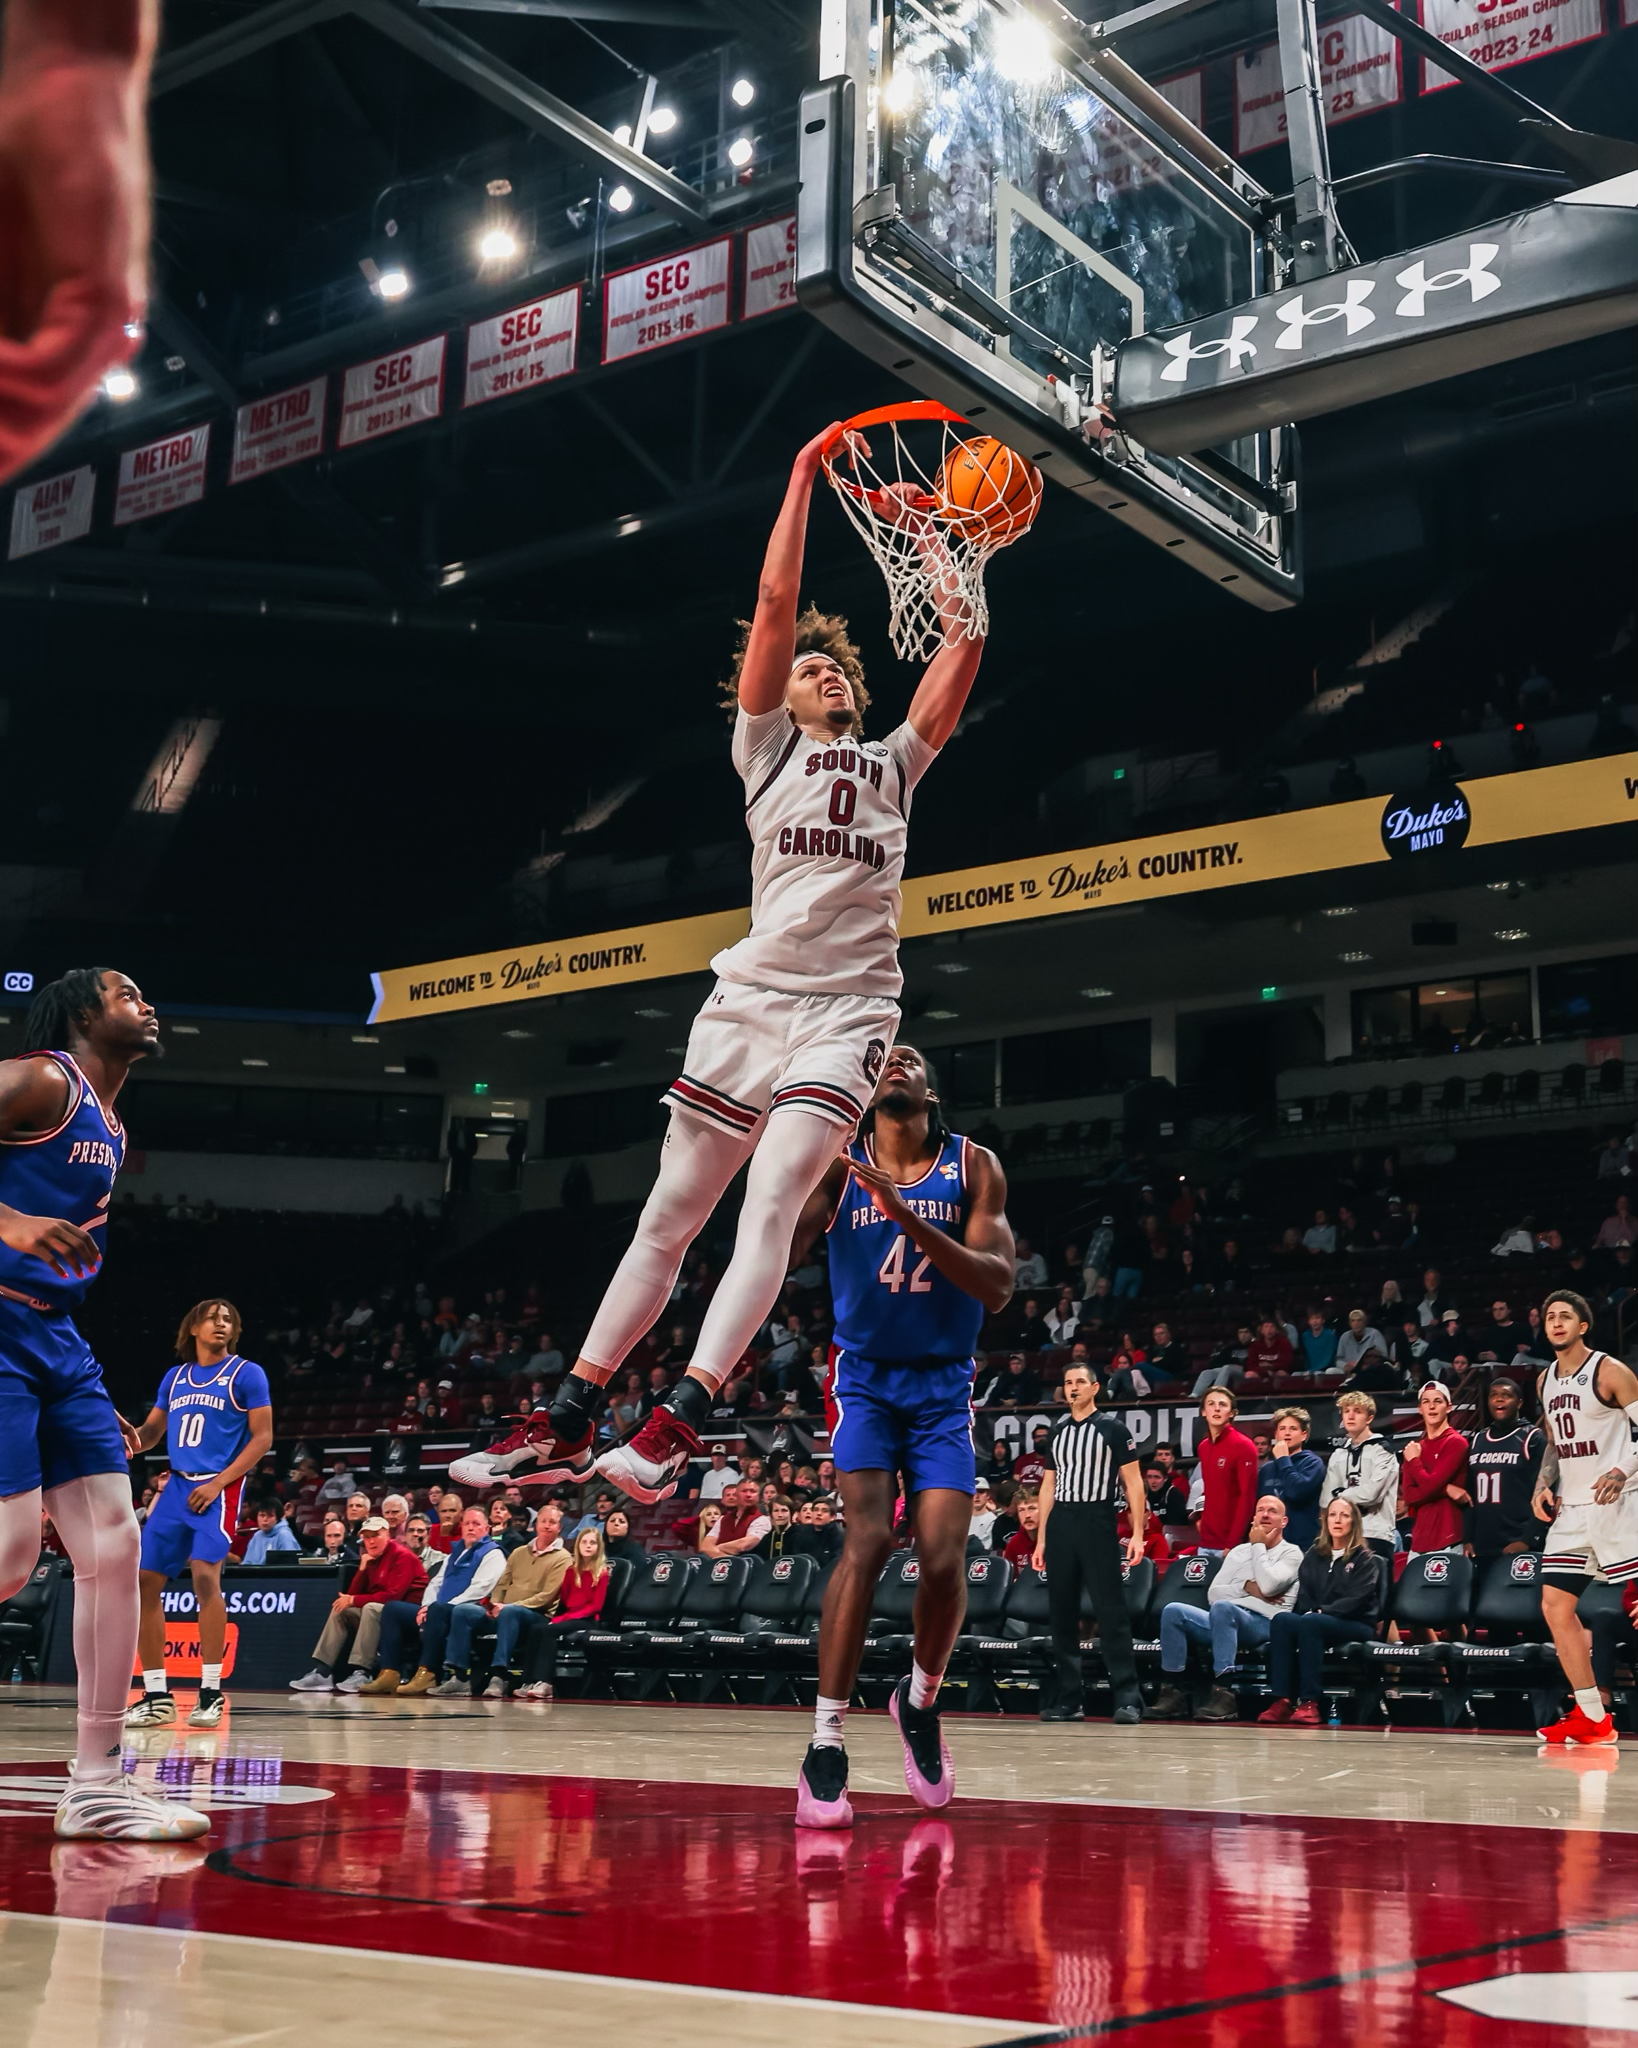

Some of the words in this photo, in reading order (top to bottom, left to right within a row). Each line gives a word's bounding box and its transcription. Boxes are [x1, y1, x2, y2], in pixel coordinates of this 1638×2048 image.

[1437, 1, 1529, 44] EGULAR-SEASON
[1469, 24, 1554, 66] 2023-24
[1335, 51, 1391, 84] CHAMPION
[645, 260, 690, 301] SEC
[501, 307, 542, 347] SEC
[637, 313, 694, 345] 2015-16
[373, 354, 412, 392] SEC
[493, 361, 544, 392] 2014-15
[250, 388, 310, 434] METRO
[133, 435, 192, 480] METRO
[32, 474, 76, 513] AIAW
[805, 749, 883, 793] SOUTH
[828, 778, 857, 826] 0
[1386, 799, 1467, 839] Duke's
[779, 827, 885, 872] CAROLINA
[1411, 828, 1444, 852] MAYO
[927, 882, 1015, 916] WELCOME
[1020, 879, 1039, 897] TO
[1048, 856, 1130, 899] Duke's
[1138, 842, 1243, 879] COUNTRY.
[7, 975, 30, 989] CC
[409, 973, 476, 1002] WELCOME
[480, 971, 494, 987] TO
[500, 953, 562, 989] Duke's
[569, 943, 647, 974] COUNTRY.
[852, 1199, 961, 1230] PRETERIAN
[879, 1234, 932, 1293] 42
[169, 1393, 225, 1412] PRESBYTERIAN
[1549, 1393, 1581, 1414] SOUTH
[178, 1413, 206, 1448] 10
[1555, 1412, 1576, 1440] 10
[1479, 1452, 1520, 1465] COCKPIT
[1477, 1472, 1502, 1504] 01
[710, 1635, 745, 1644] GAMECOCKS
[979, 1641, 1018, 1650] GAMECOCKS
[1373, 1647, 1420, 1656] GAMECOCKS
[1462, 1648, 1510, 1656] GAMECOCKS
